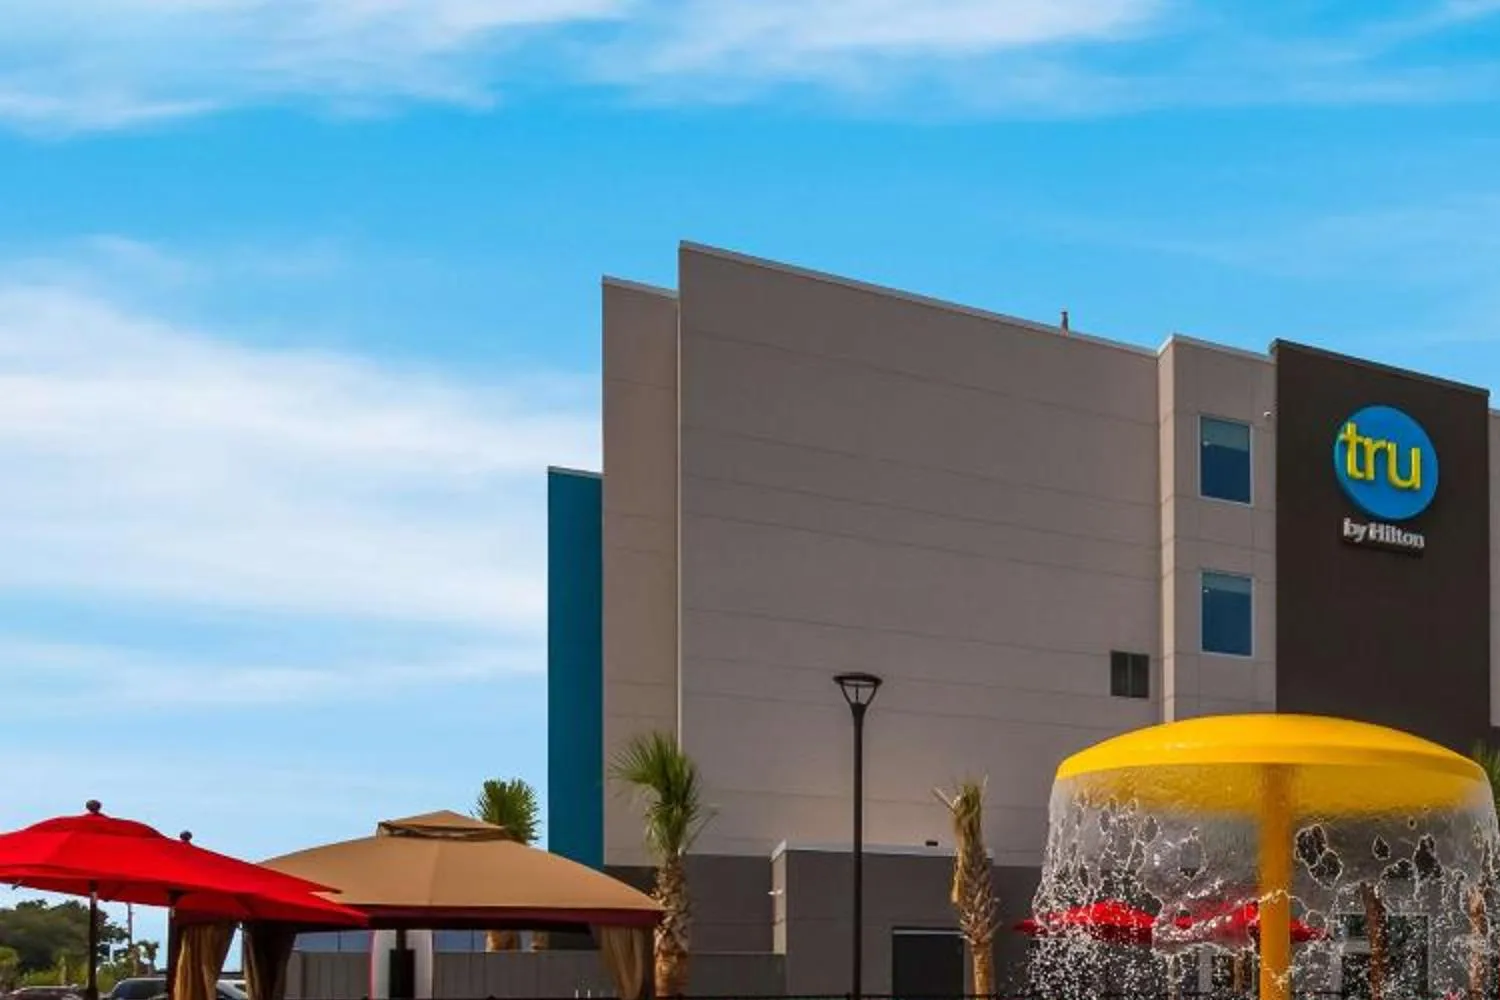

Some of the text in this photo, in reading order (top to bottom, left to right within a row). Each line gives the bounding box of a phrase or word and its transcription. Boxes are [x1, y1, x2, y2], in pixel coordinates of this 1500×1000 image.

[1342, 422, 1421, 490] tru
[1343, 518, 1424, 548] by Hilton
